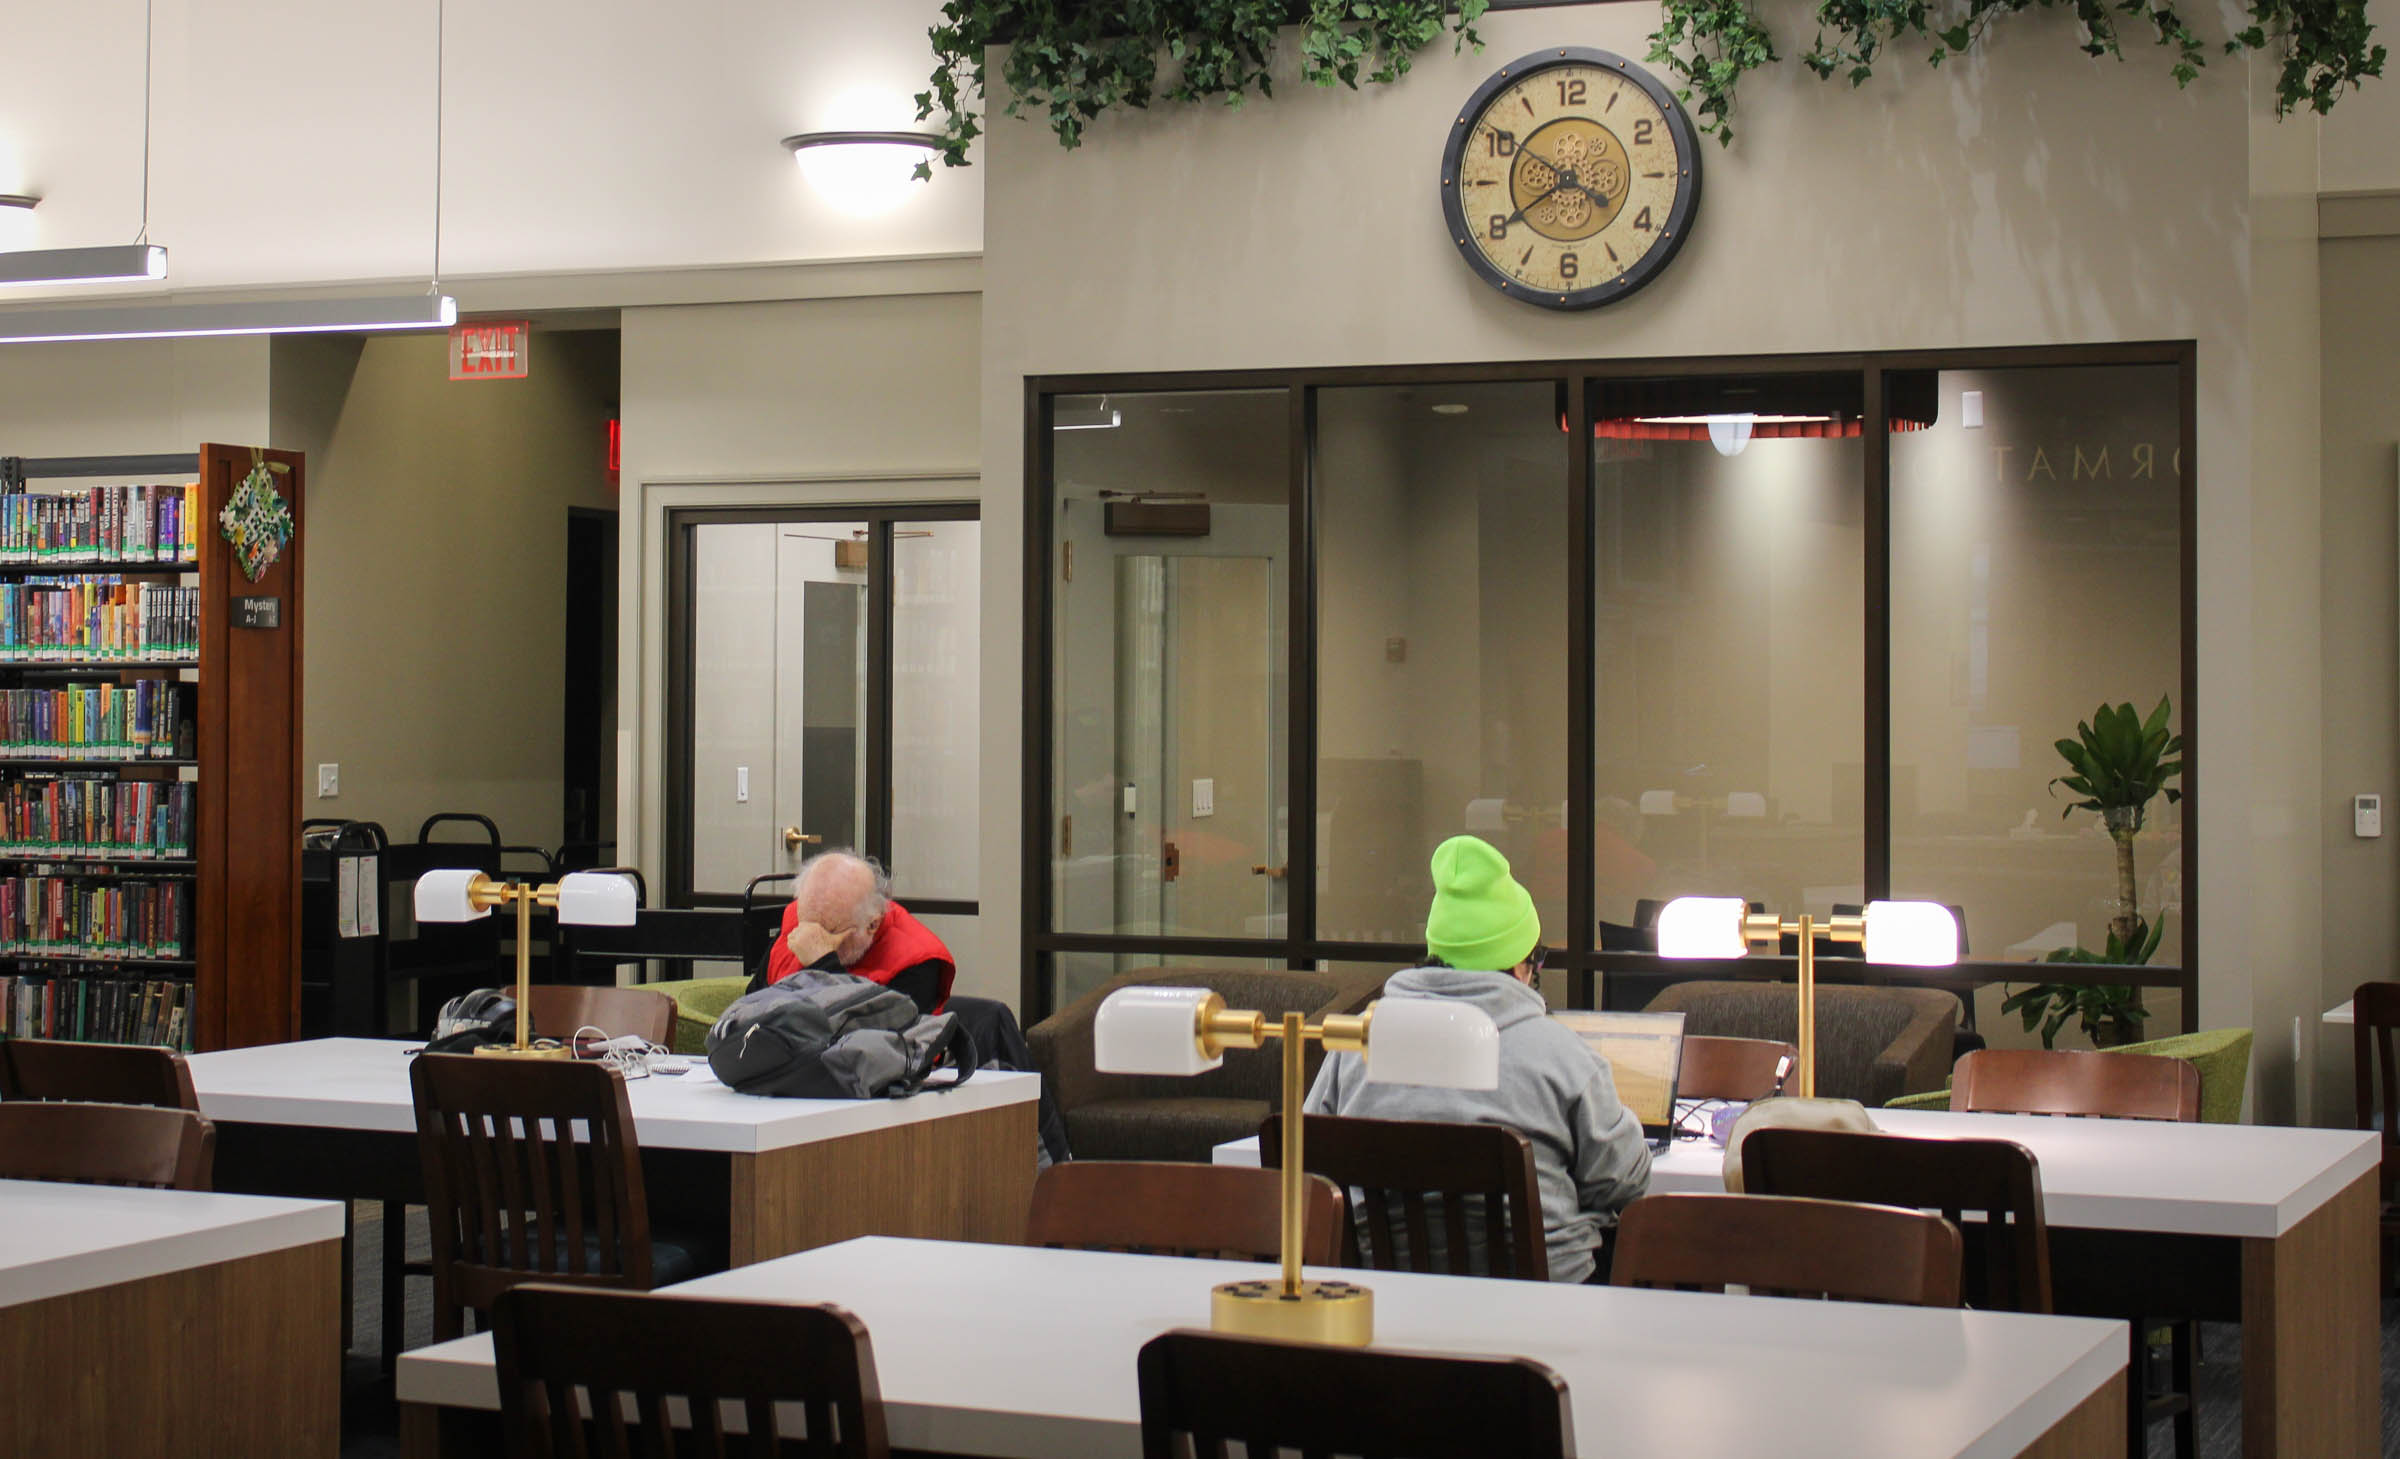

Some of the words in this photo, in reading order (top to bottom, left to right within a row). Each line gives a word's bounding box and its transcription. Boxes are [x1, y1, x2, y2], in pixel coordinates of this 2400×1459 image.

[1556, 79, 1587, 106] 12
[1486, 131, 1515, 157] 10
[1634, 119, 1653, 145] 2
[1489, 213, 1508, 240] 8
[1633, 205, 1653, 233] 4
[1559, 252, 1578, 279] 6
[461, 327, 519, 373] EXIT
